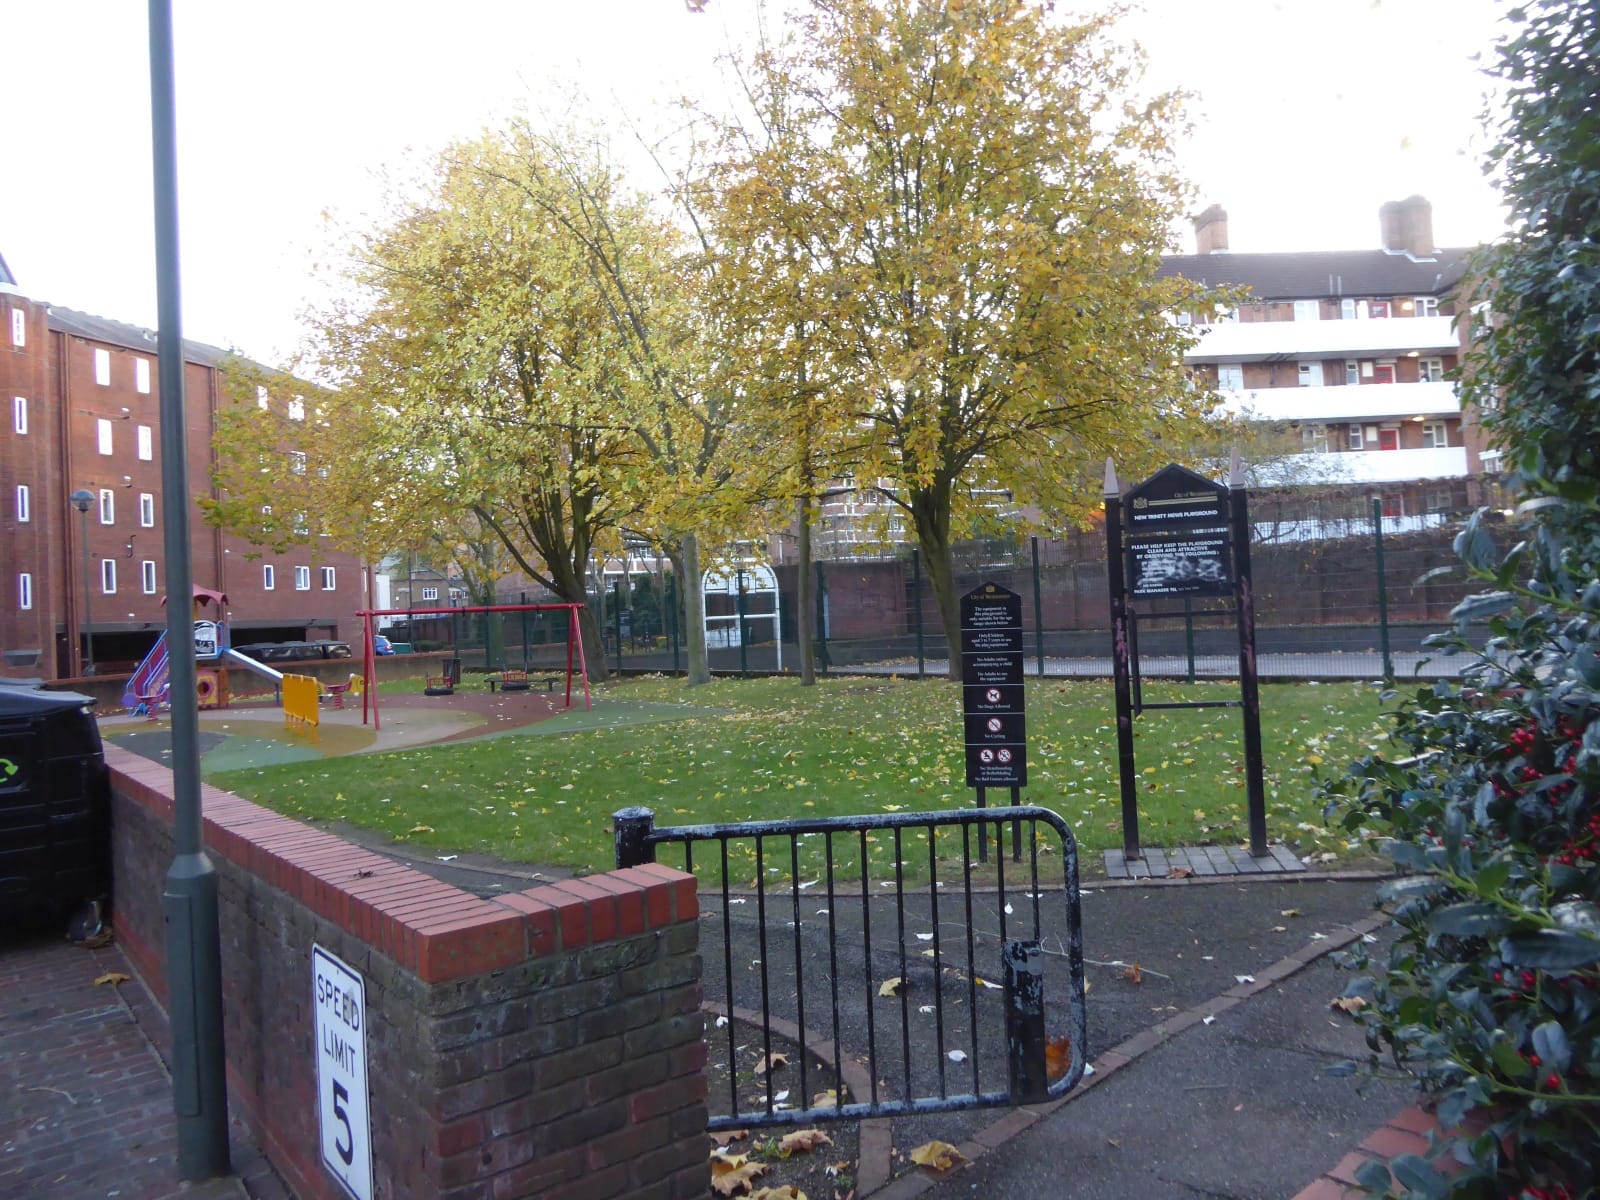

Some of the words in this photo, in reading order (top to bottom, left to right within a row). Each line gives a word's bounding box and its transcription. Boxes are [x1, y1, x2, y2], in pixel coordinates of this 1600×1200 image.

[317, 973, 360, 1032] SPEED
[323, 1023, 356, 1078] LIMIT
[332, 1077, 354, 1166] 5
